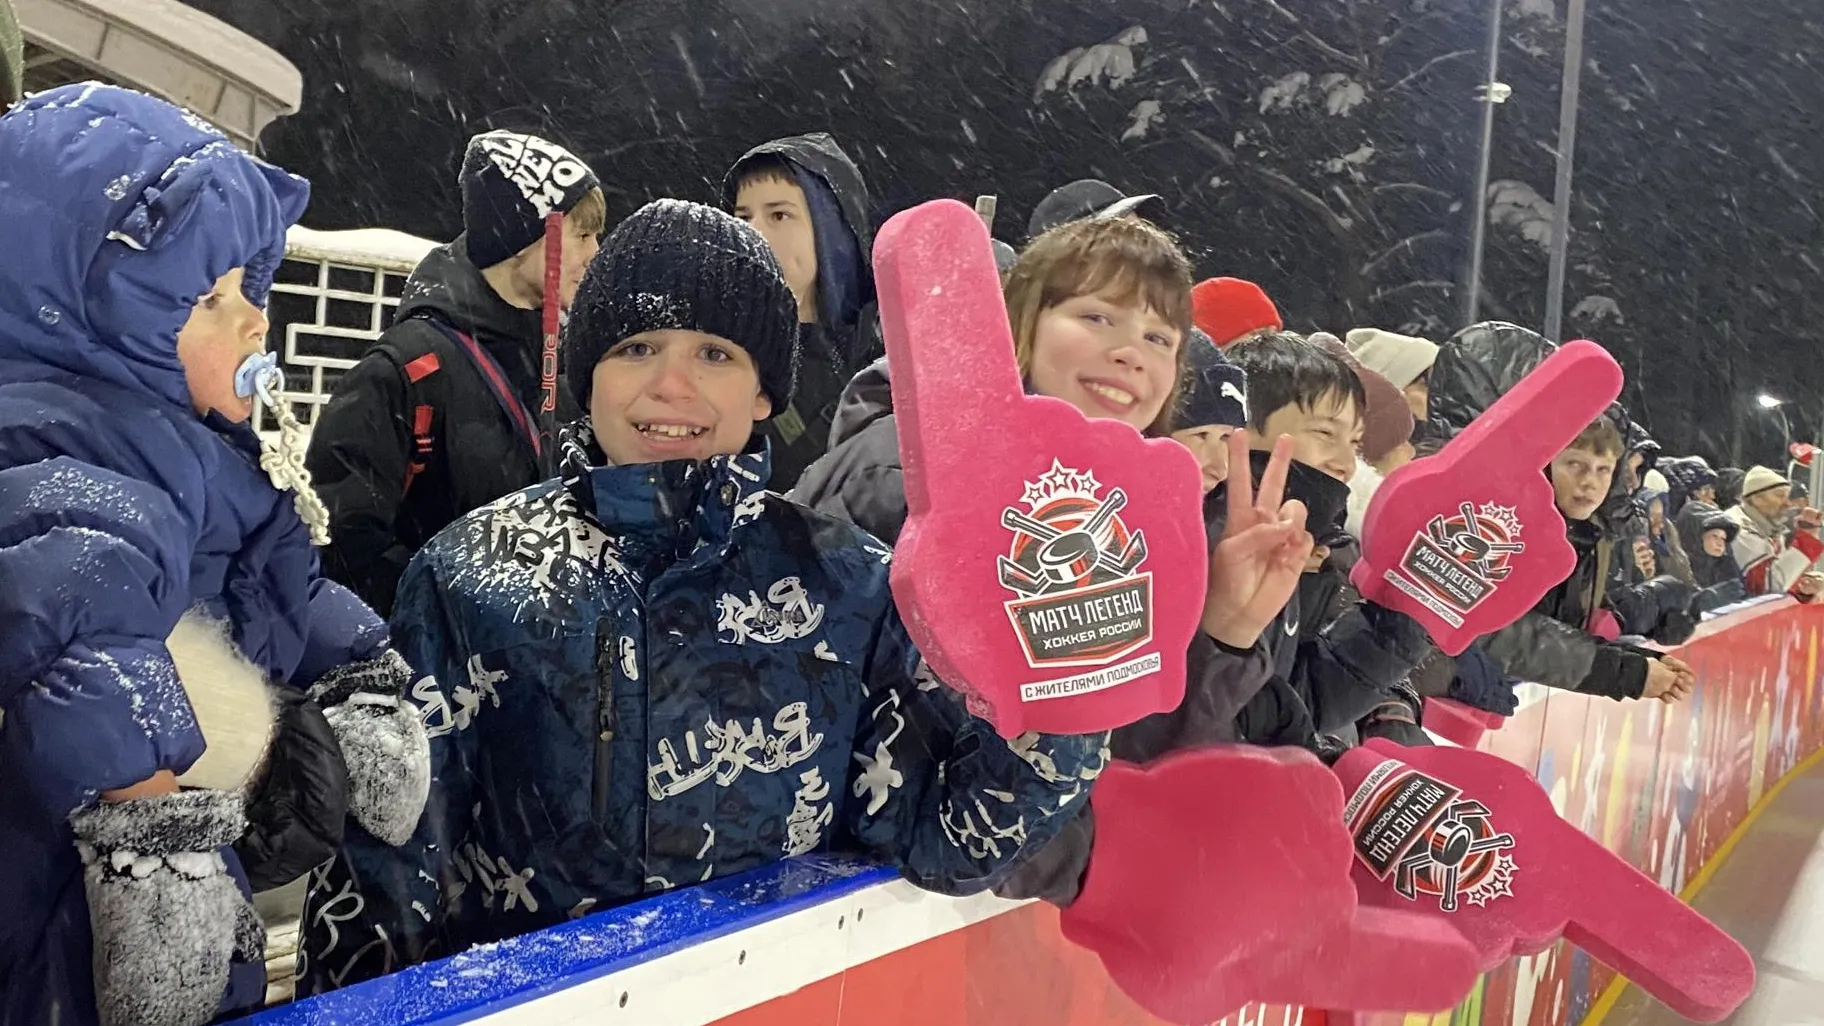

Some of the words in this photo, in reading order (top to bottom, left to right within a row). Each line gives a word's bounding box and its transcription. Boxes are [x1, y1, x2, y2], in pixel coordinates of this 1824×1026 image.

[1416, 546, 1449, 574] МАТЧ
[1446, 561, 1484, 599] ЛЕГЕНД
[1029, 603, 1082, 635] МАТЧ
[1086, 590, 1144, 624] ЛЕГЕНД
[1042, 631, 1096, 650] ХОККЕЯ
[1100, 618, 1142, 637] РОССИИ
[1025, 685, 1033, 699] С
[1035, 674, 1105, 696] ЖИТЕЛЯМИ
[1394, 779, 1424, 810] ХОККЕЯ
[1413, 783, 1446, 817] МАТЧ
[1363, 807, 1396, 846] РОССИИ
[1369, 813, 1419, 863] ЛЕГЕНД
